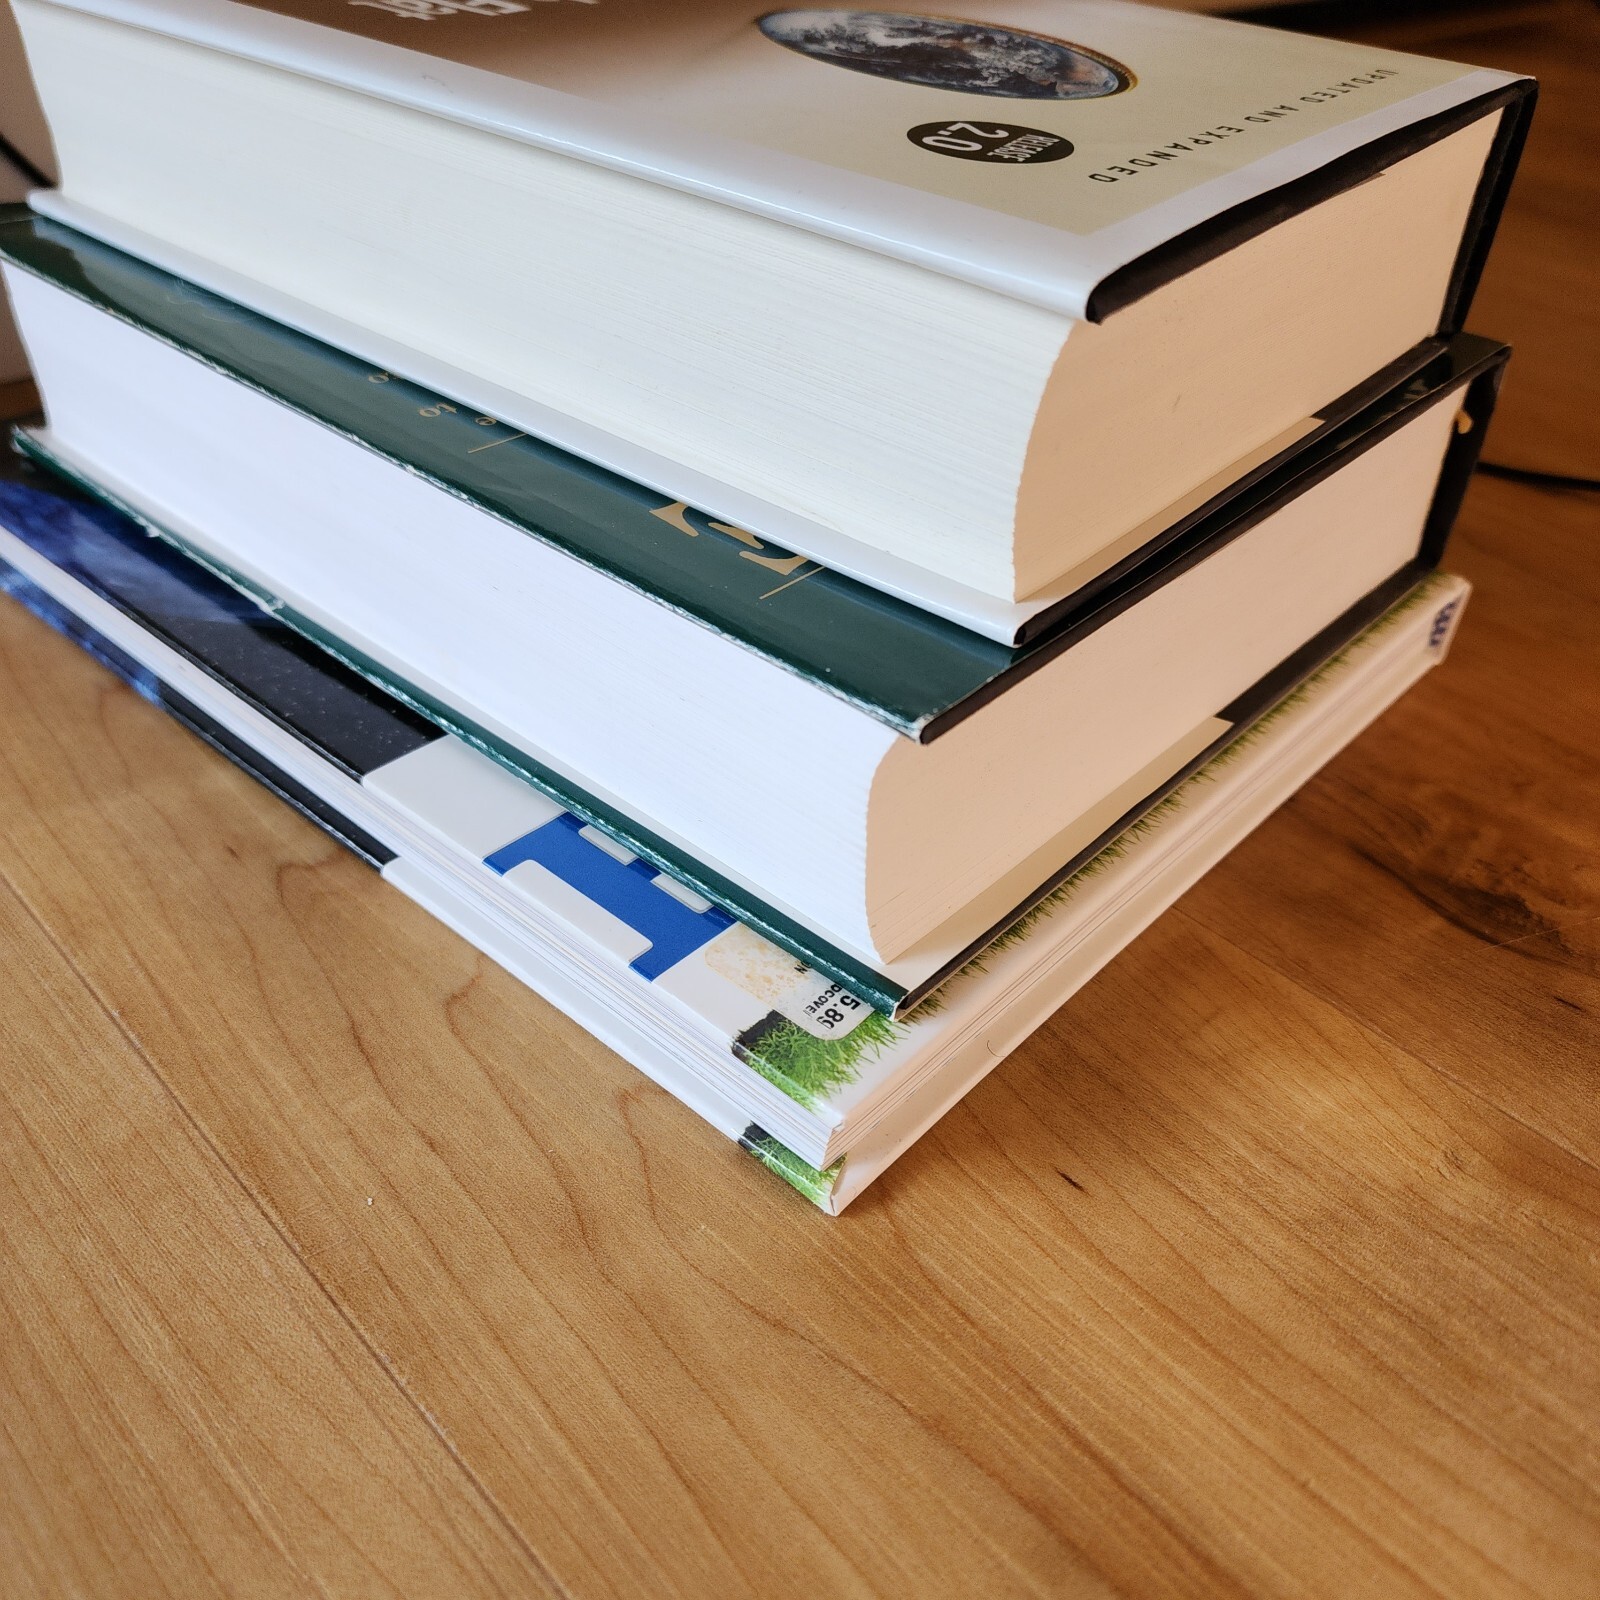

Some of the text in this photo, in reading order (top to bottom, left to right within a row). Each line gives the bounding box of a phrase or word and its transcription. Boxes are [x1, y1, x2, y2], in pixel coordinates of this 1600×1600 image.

[922, 122, 1009, 151] 2.0
[1088, 69, 1399, 183] UPDATED AND EXPANDED
[987, 134, 1060, 162] RELEASE
